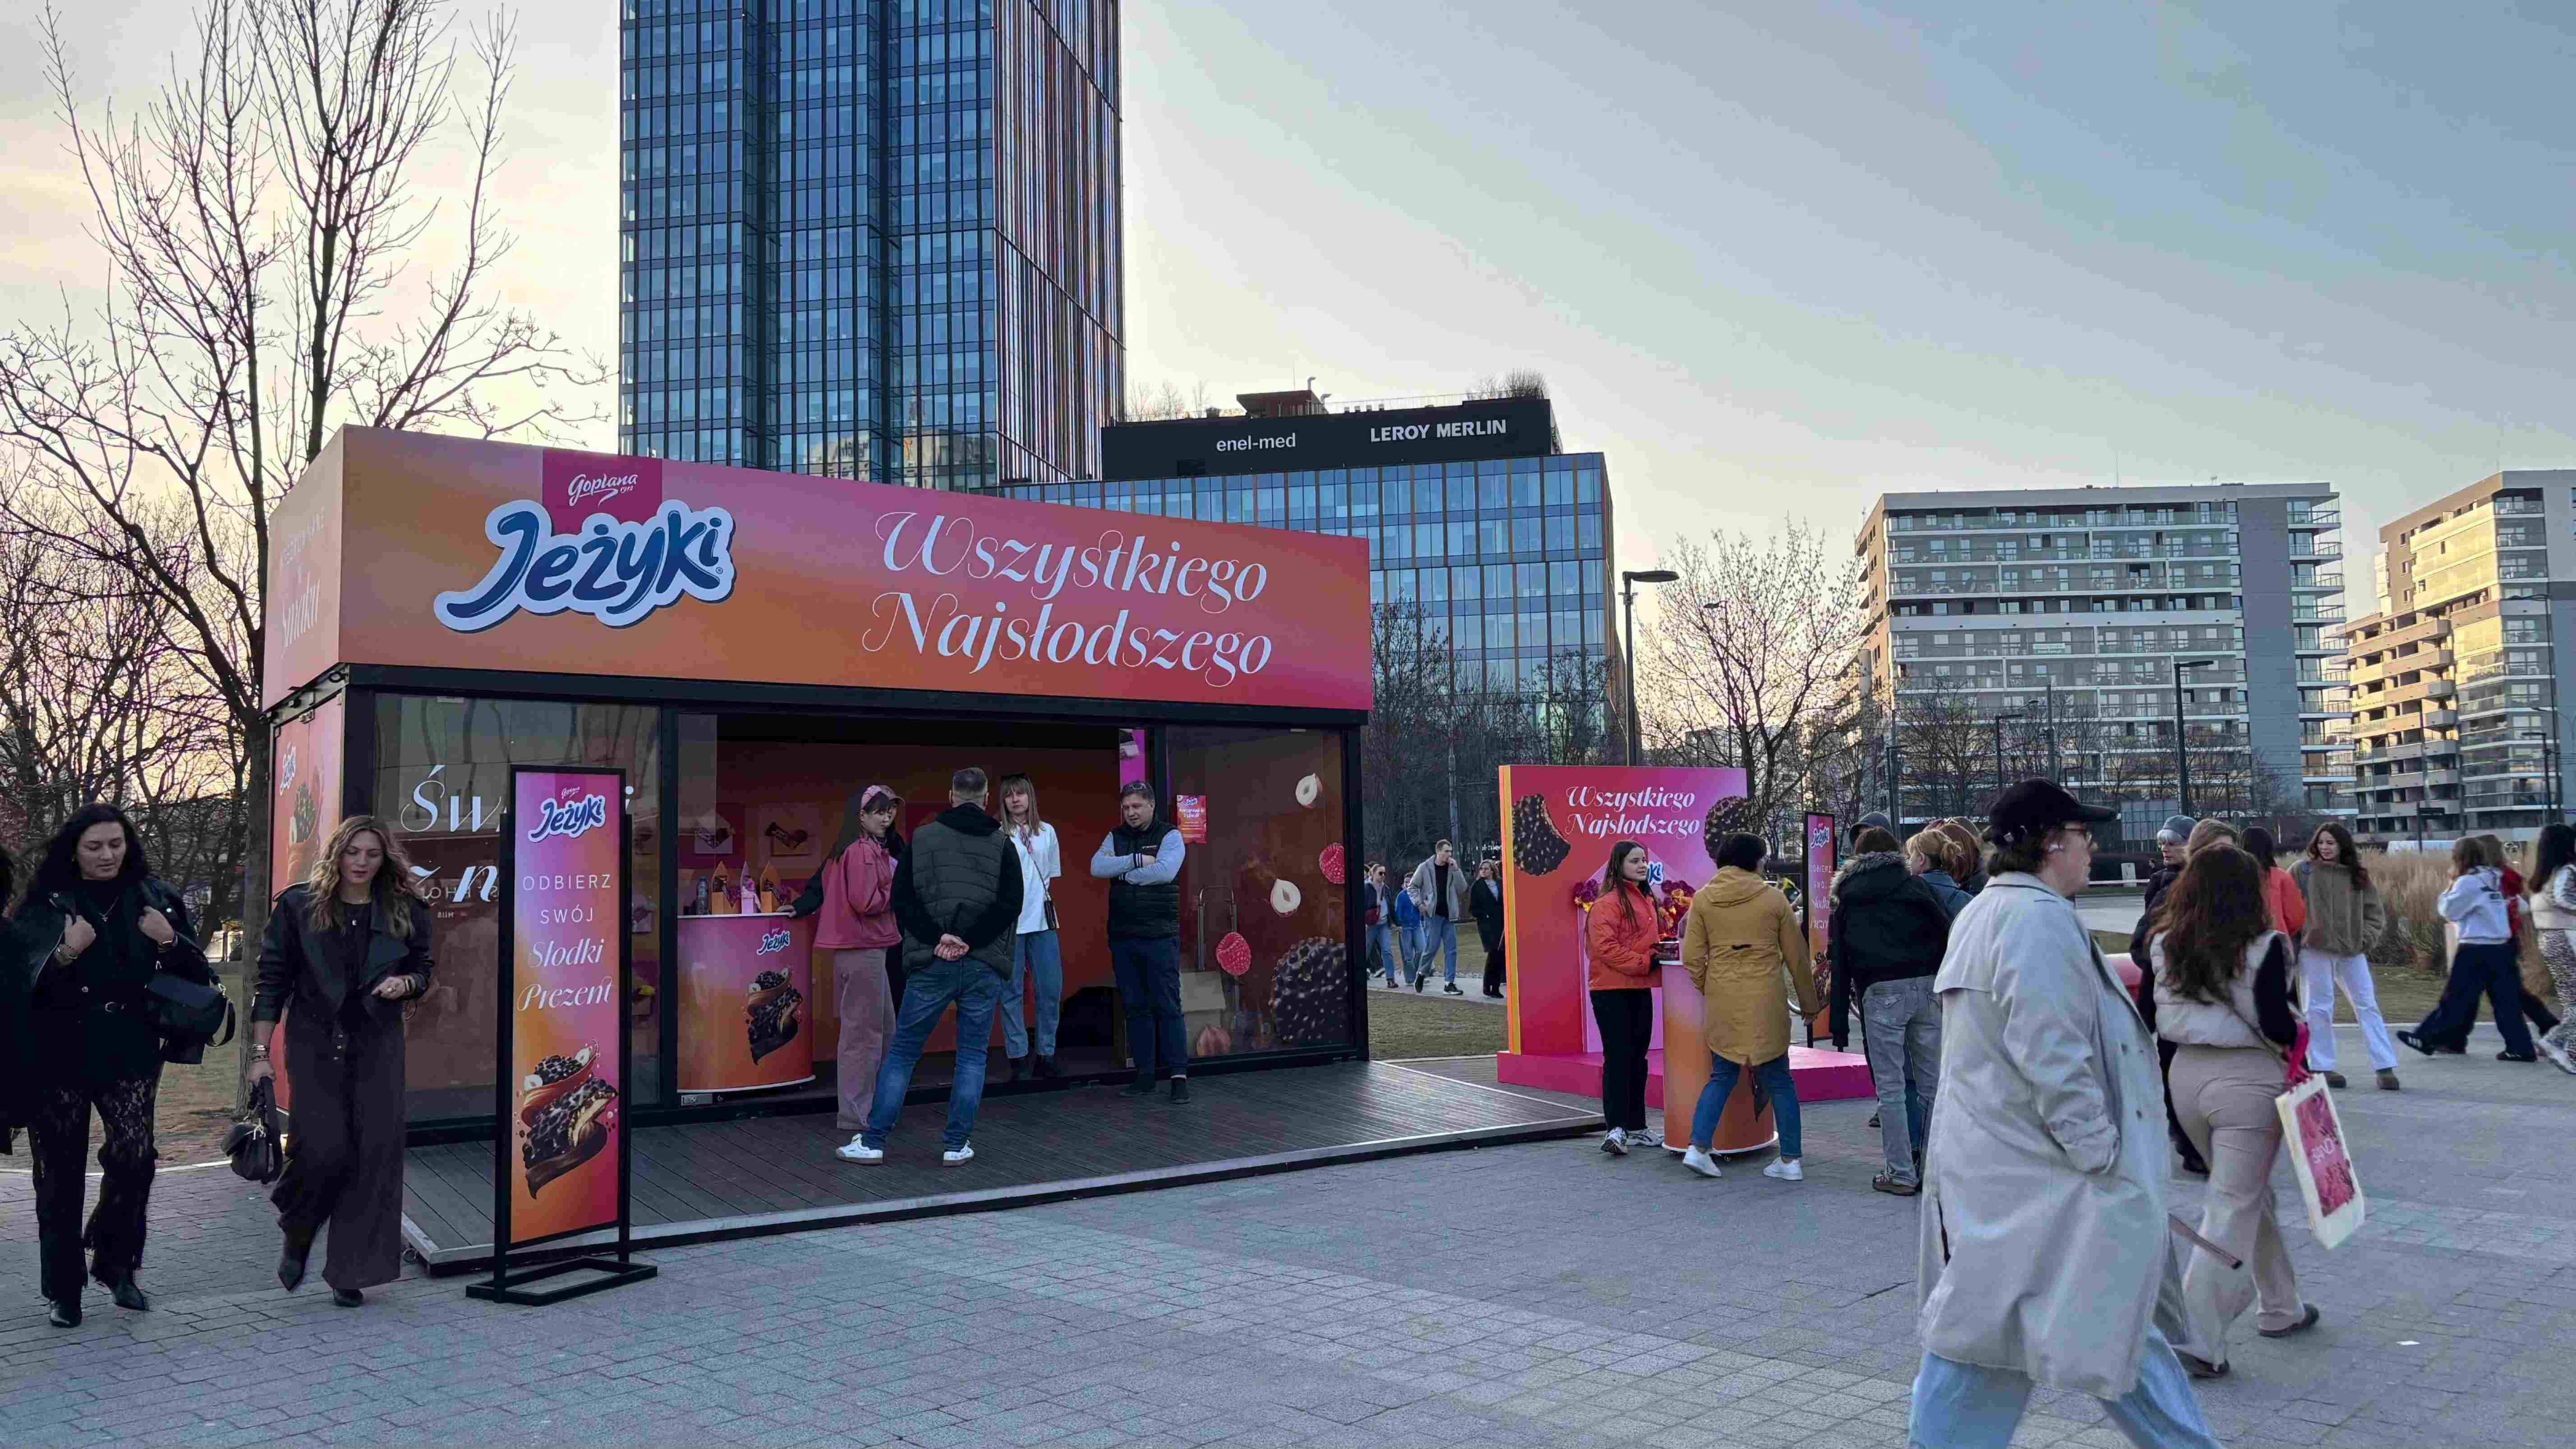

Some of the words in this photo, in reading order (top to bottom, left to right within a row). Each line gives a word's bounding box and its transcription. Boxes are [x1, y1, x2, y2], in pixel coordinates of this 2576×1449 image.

[1216, 432, 1296, 452] enel-med
[1370, 424, 1430, 442] LEROY
[1436, 419, 1507, 438] MERLIN
[568, 473, 638, 508] Goplana
[443, 508, 724, 621] Jeżyki
[875, 511, 1267, 614] Wszystkiego
[862, 592, 1272, 687] Najsłodszego
[1566, 786, 1695, 813] Wszystkiego
[529, 796, 603, 839] Jeżyki
[523, 874, 611, 891] ODBIERZ
[540, 904, 593, 924] SWÓJ
[516, 975, 614, 1011] Prezent
